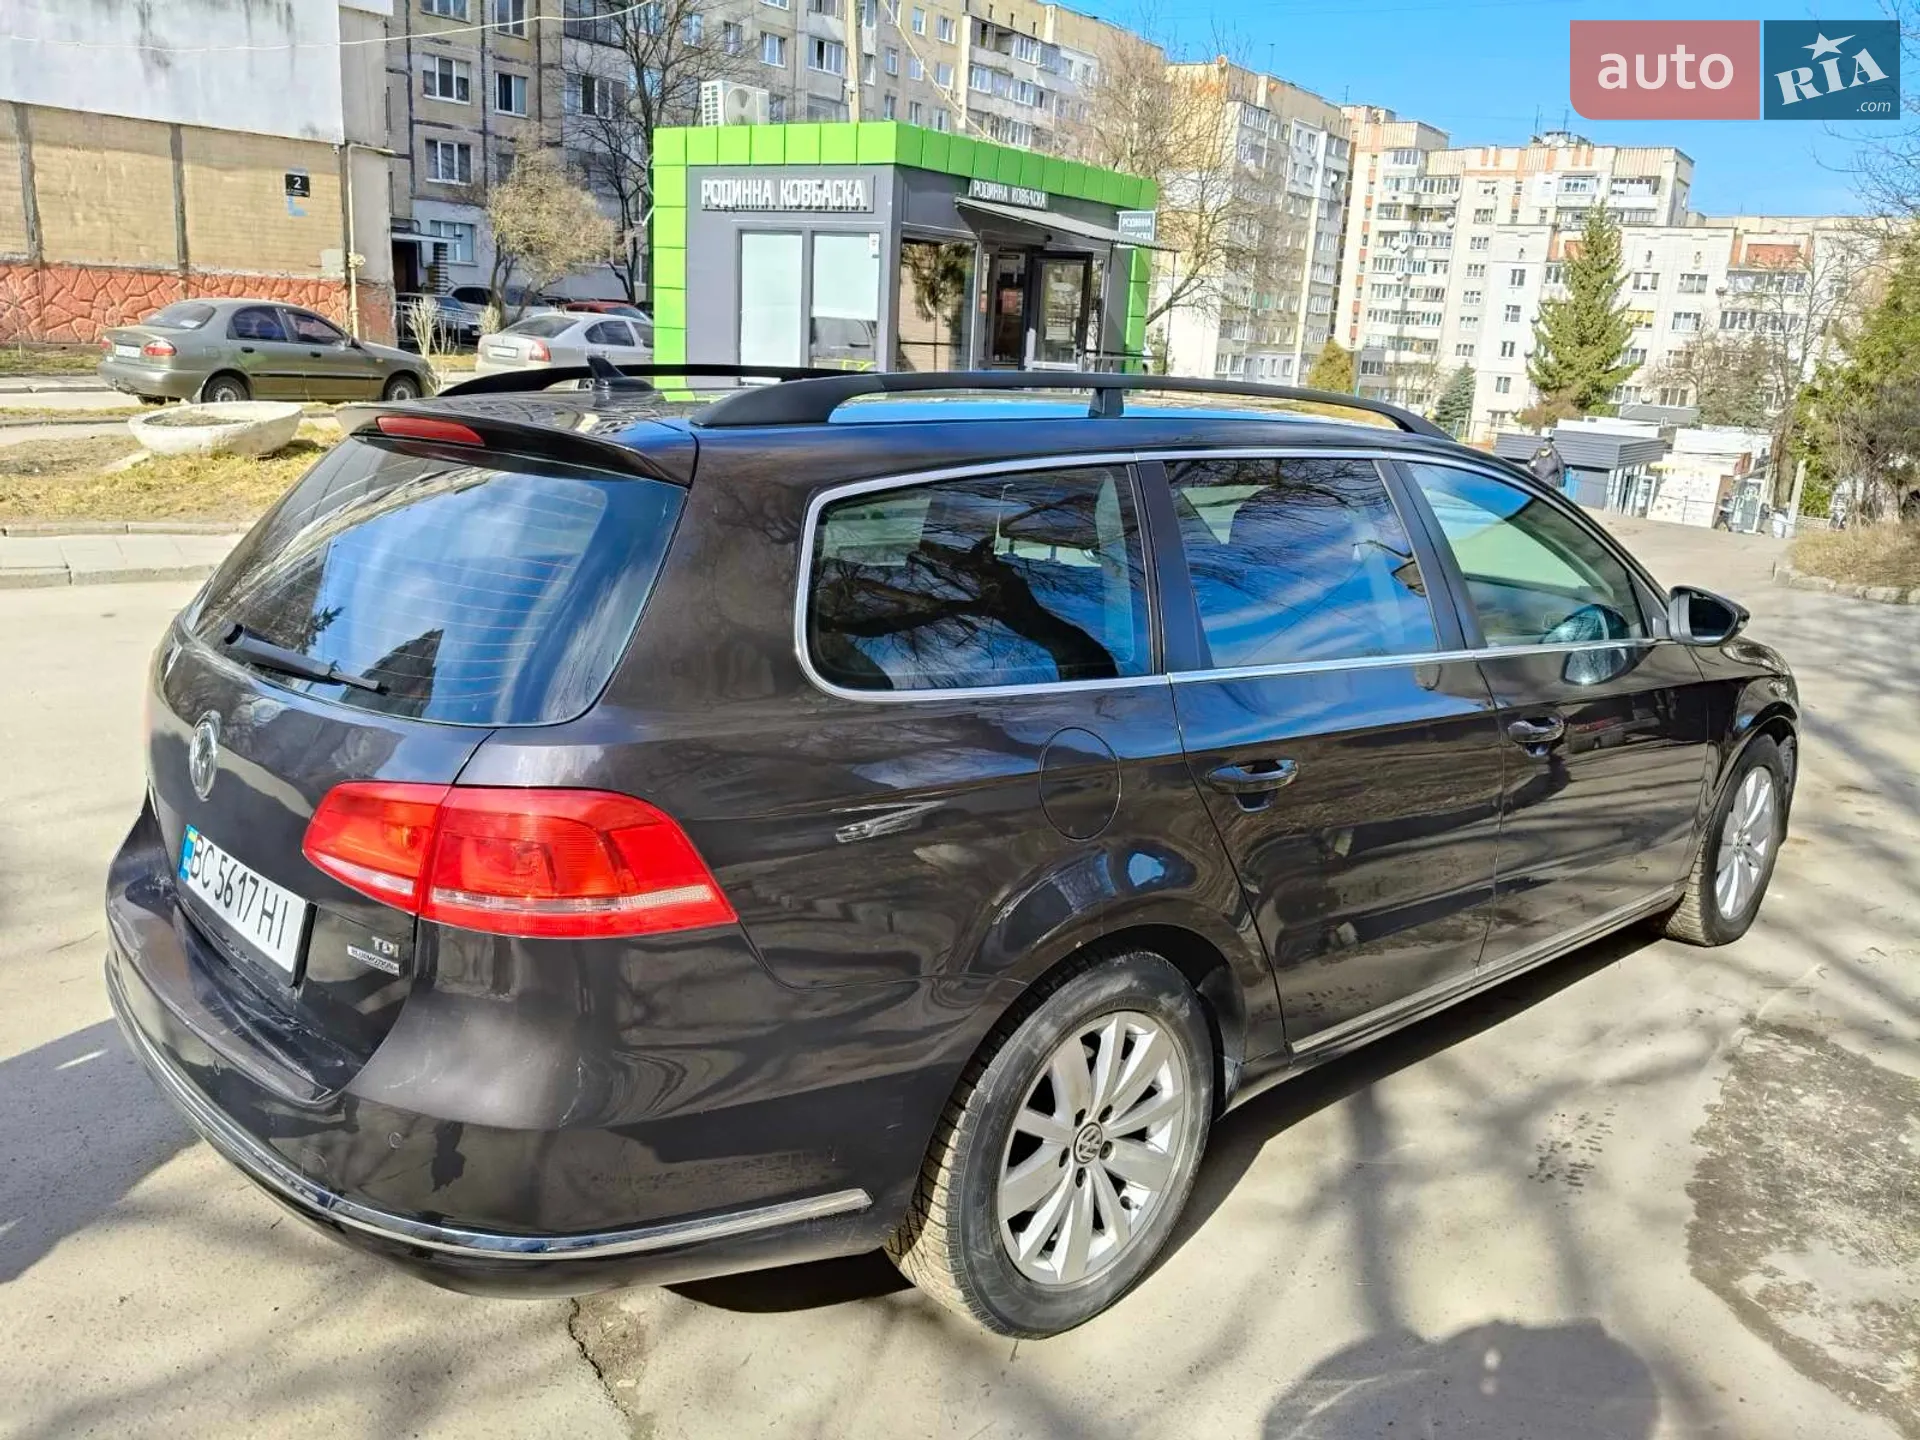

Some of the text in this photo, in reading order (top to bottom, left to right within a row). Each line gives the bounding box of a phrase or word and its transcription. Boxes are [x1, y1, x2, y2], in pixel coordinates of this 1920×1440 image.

[293, 176, 302, 189] 2
[701, 179, 867, 208] РОДИННА КОВБАСКА
[190, 834, 289, 950] BC 5617 HI
[371, 935, 399, 958] TDI
